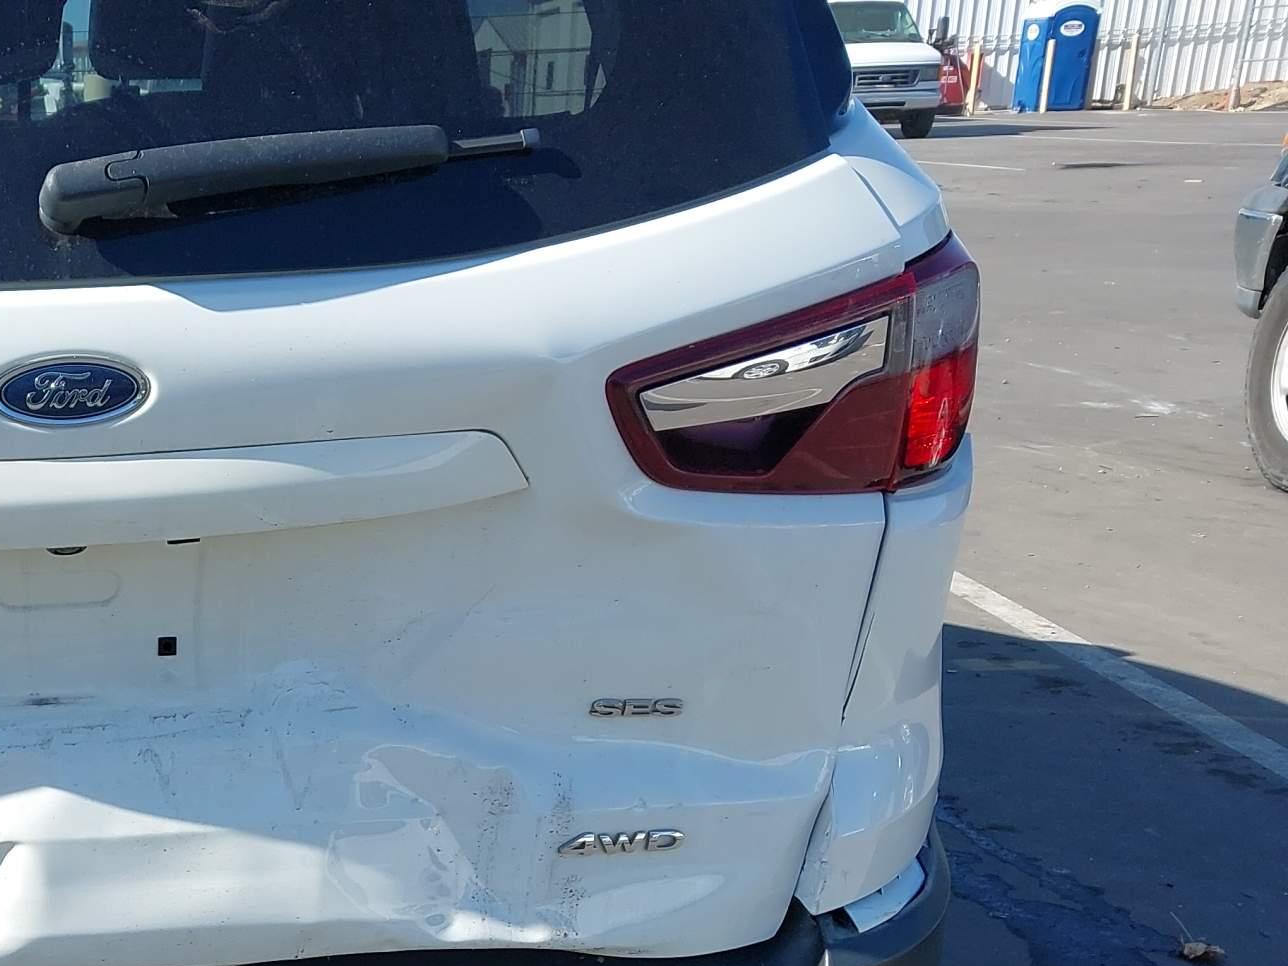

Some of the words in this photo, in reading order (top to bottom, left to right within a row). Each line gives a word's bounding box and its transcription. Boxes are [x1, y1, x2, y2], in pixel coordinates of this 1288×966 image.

[26, 371, 112, 410] Ford
[589, 698, 683, 717] SES
[557, 829, 686, 857] 4WD
